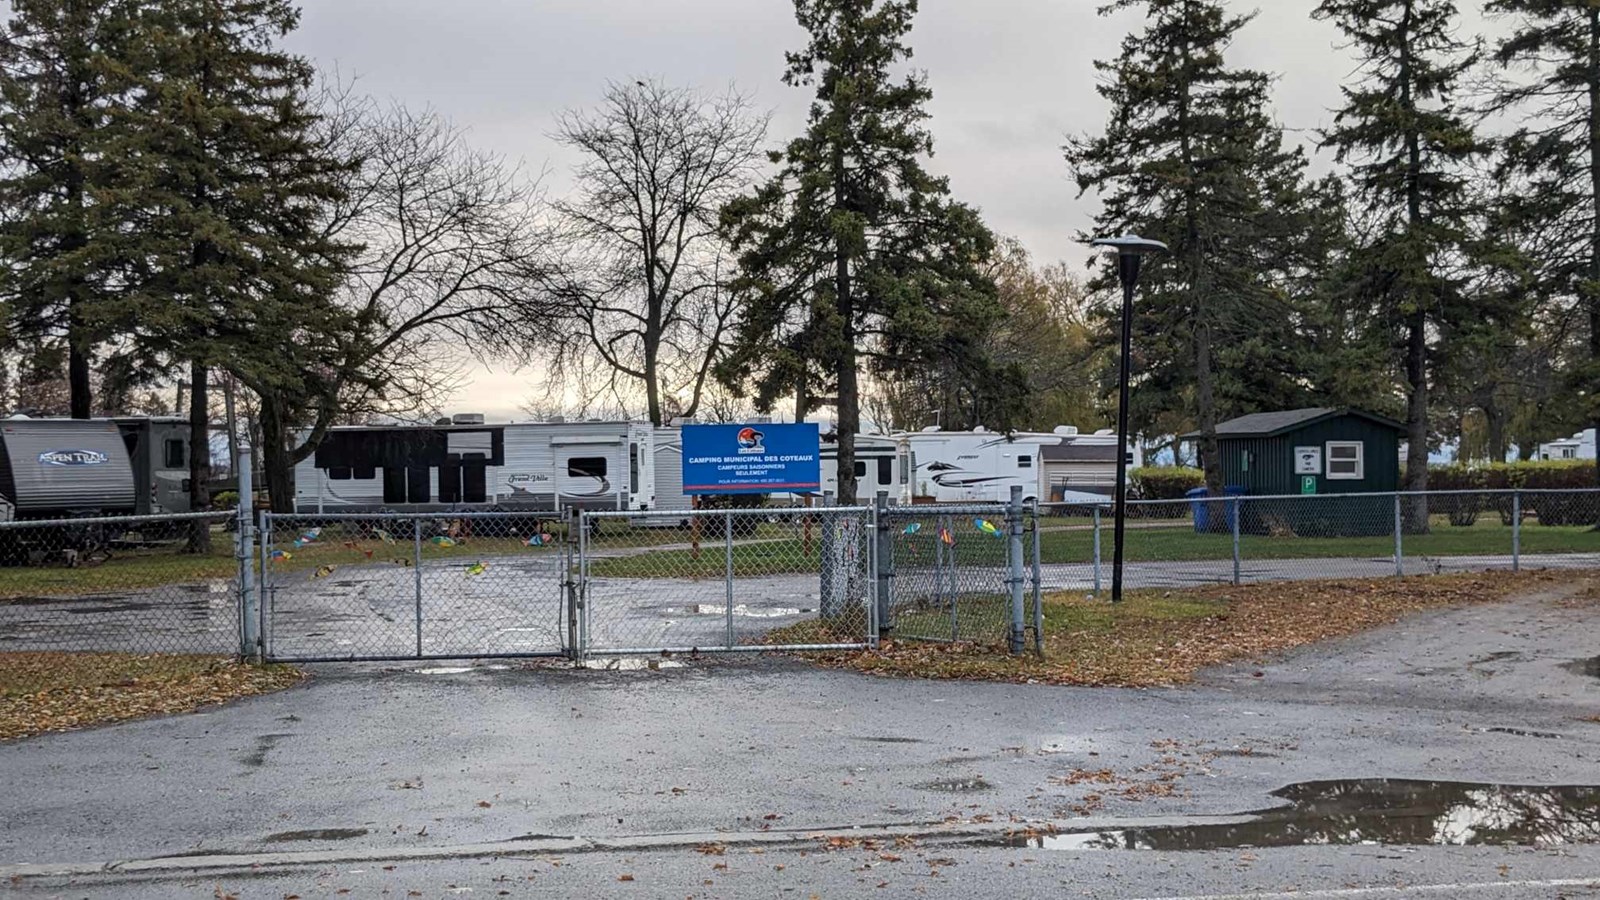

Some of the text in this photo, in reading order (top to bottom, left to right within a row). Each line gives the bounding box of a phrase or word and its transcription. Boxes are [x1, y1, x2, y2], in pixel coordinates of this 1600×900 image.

[39, 454, 72, 462] ASPEN
[74, 453, 108, 462] TRAIL
[1306, 477, 1313, 488] P
